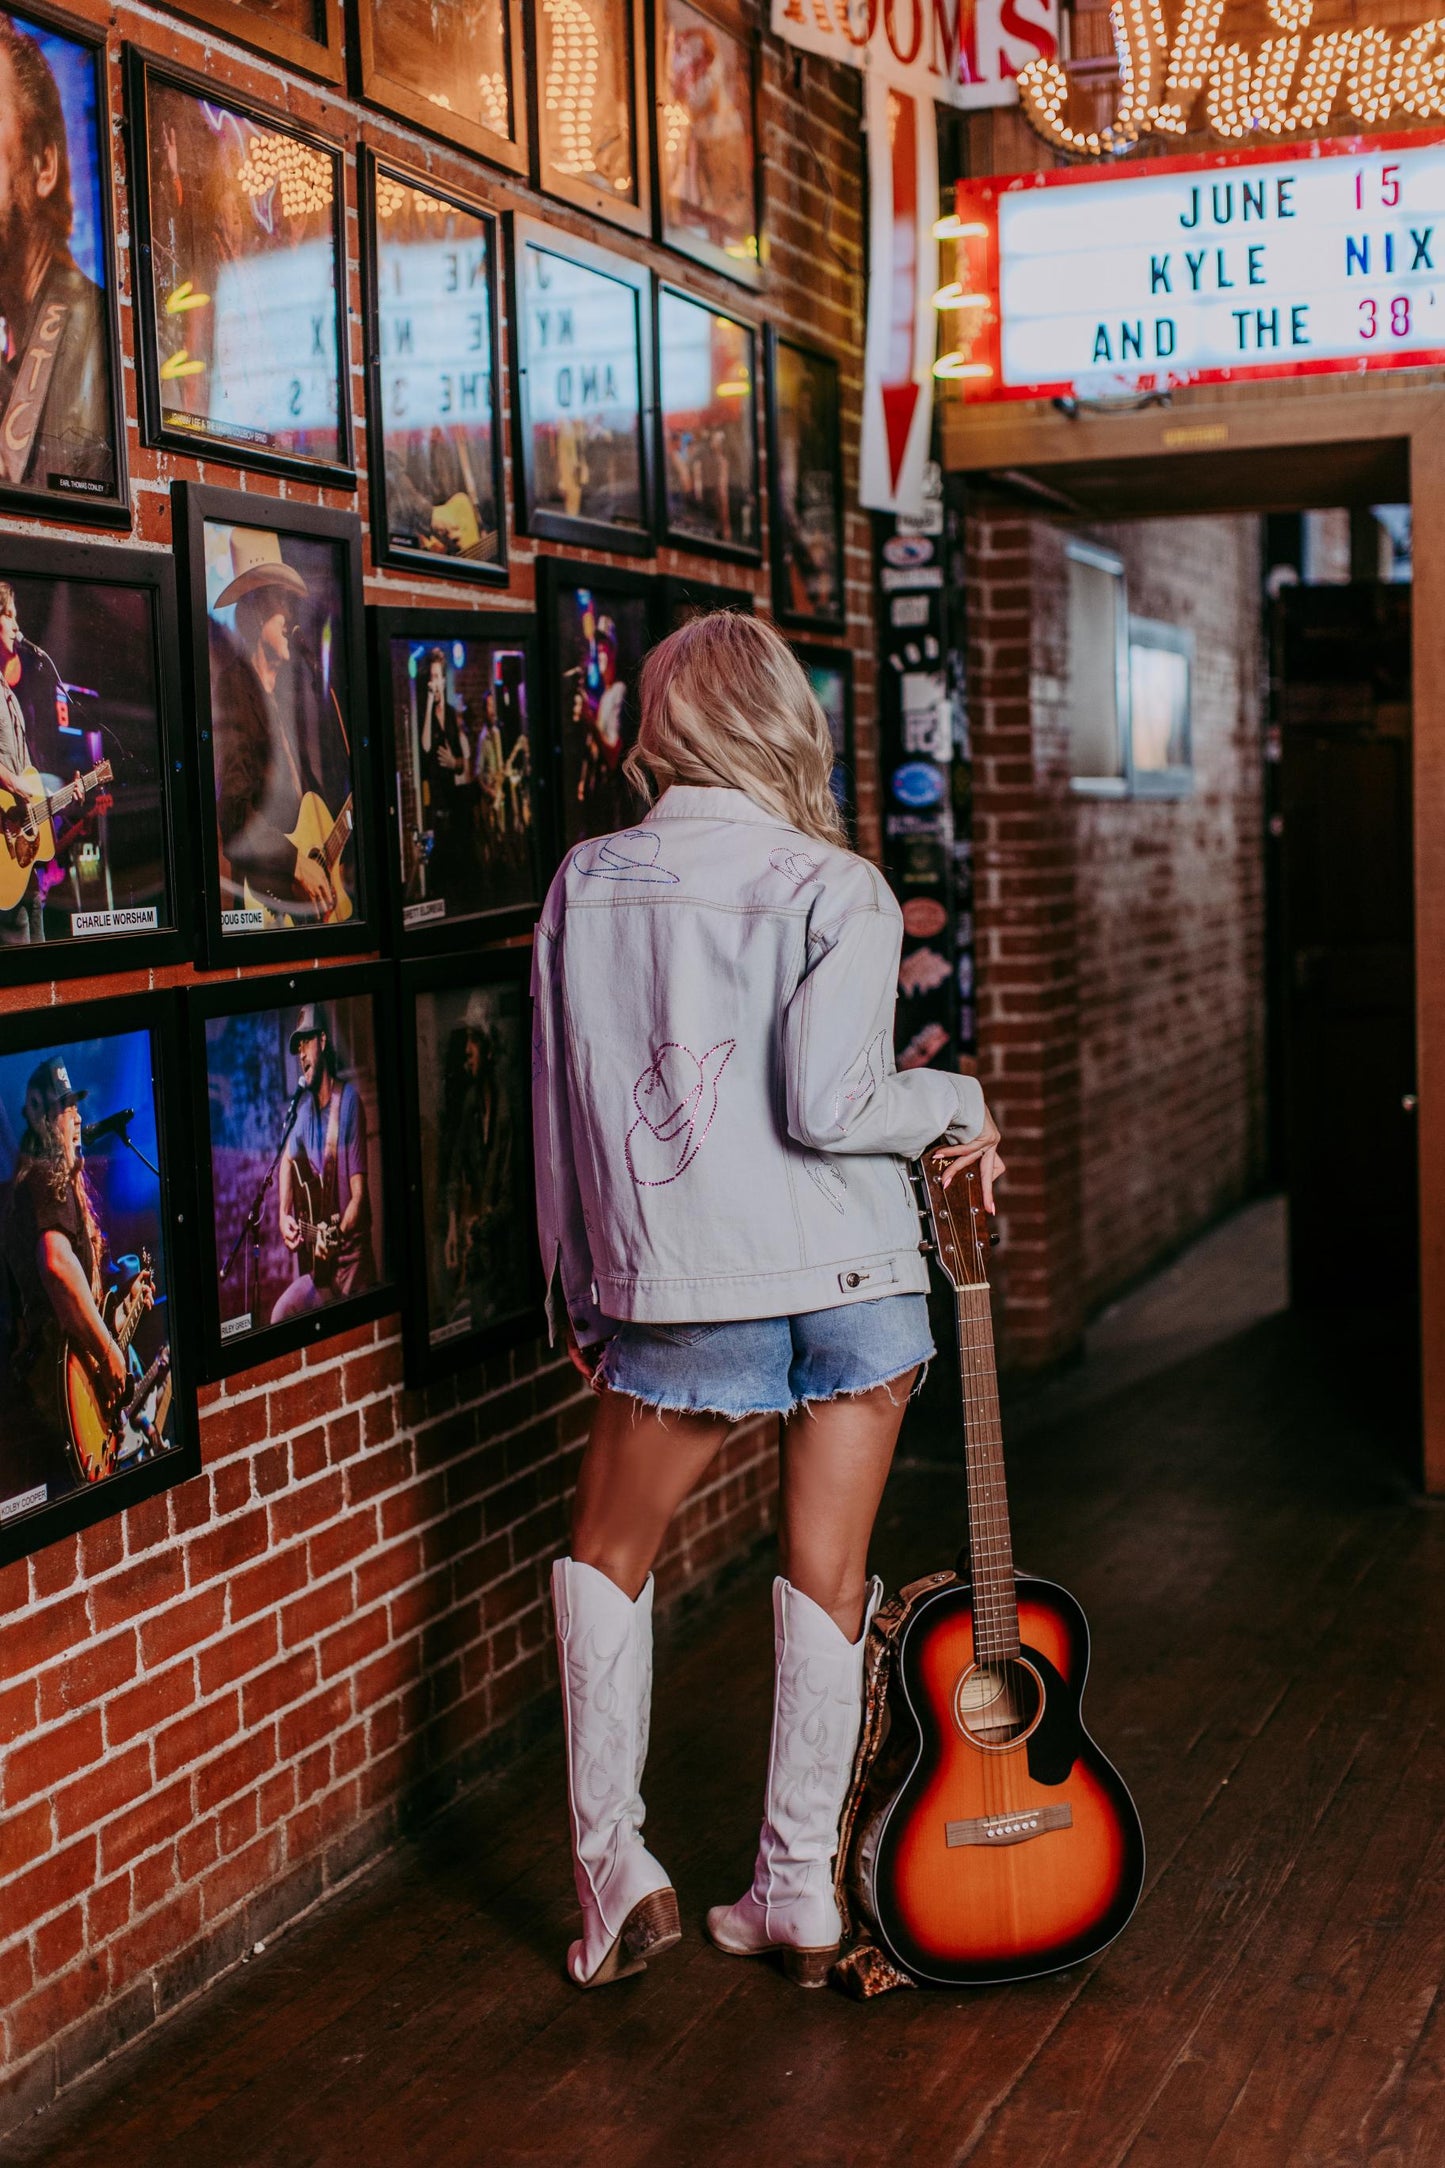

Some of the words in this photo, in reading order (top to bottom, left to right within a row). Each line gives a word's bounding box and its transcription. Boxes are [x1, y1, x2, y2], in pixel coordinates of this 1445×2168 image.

[1180, 175, 1296, 229] JUNE
[1353, 164, 1400, 210] 15
[1150, 244, 1266, 294] KYLE
[1346, 226, 1434, 276] NIX
[1093, 318, 1175, 363] AND
[1231, 304, 1311, 350] THE
[60, 479, 70, 488] EARL
[76, 914, 111, 929] CHARLIE
[112, 911, 154, 926] WORSHAM
[221, 914, 240, 926] DOUG
[240, 911, 263, 925] STONE
[21, 1489, 46, 1507] COOPER
